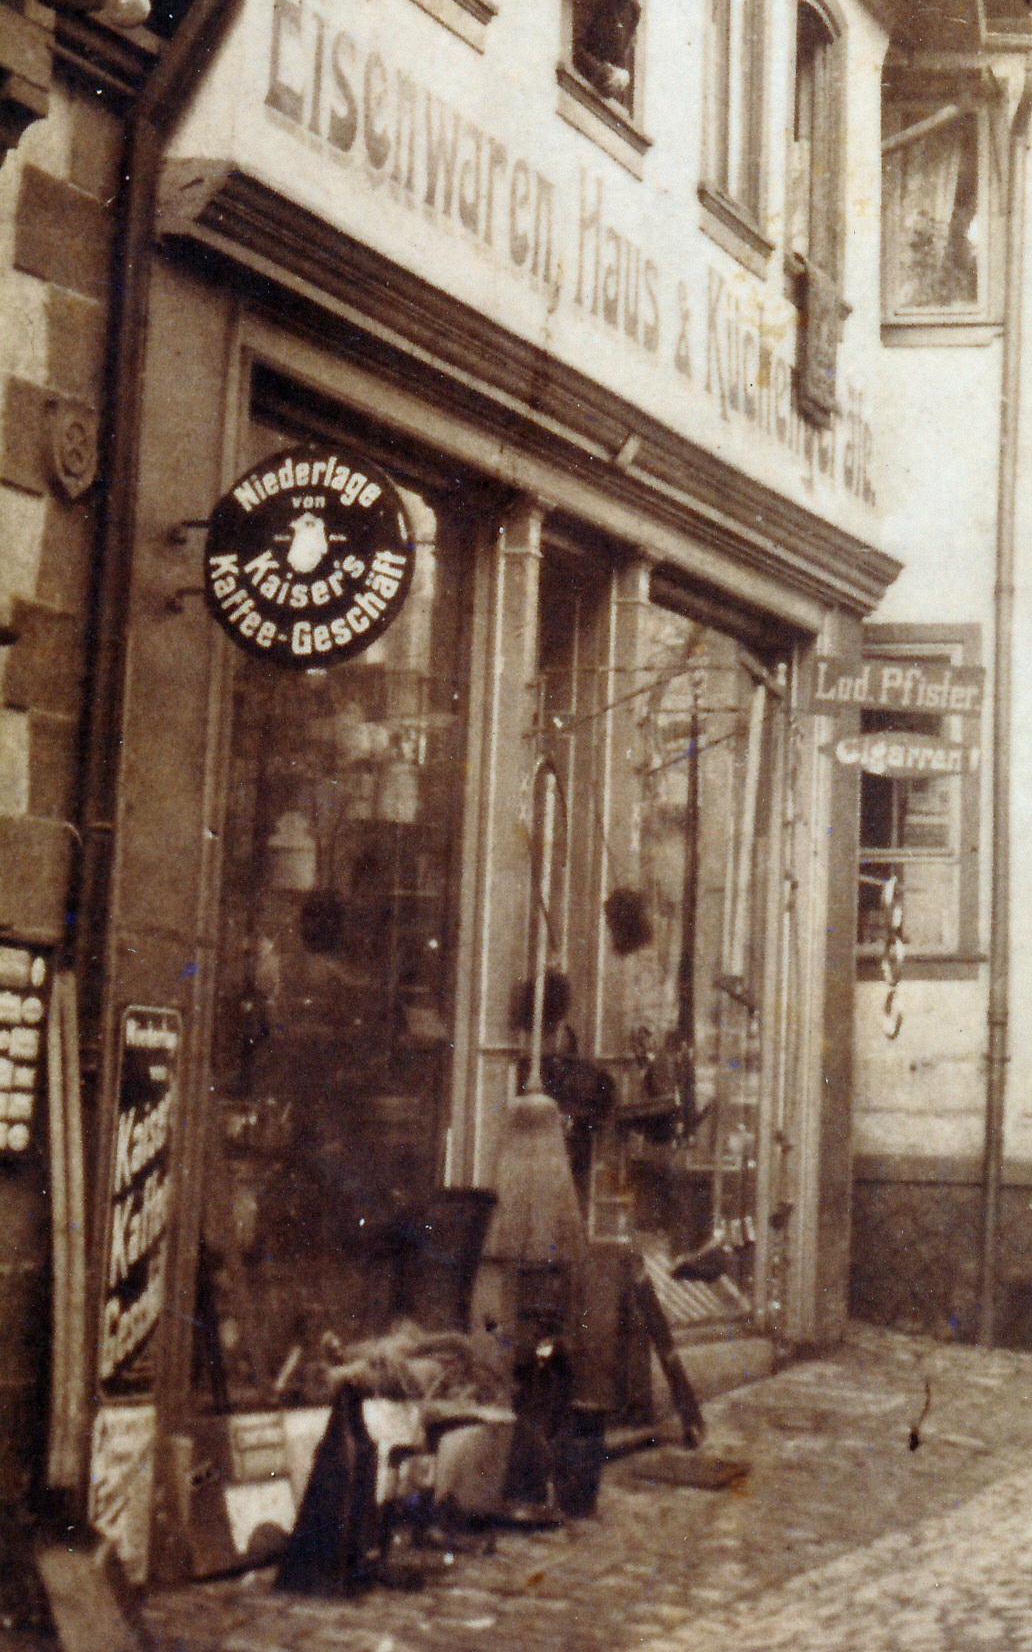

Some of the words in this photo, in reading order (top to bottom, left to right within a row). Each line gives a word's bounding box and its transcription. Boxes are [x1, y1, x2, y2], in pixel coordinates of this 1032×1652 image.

[573, 165, 660, 355] Haus
[233, 456, 383, 513] Niederlage
[291, 496, 326, 509] von
[244, 550, 366, 608] Kaiser's
